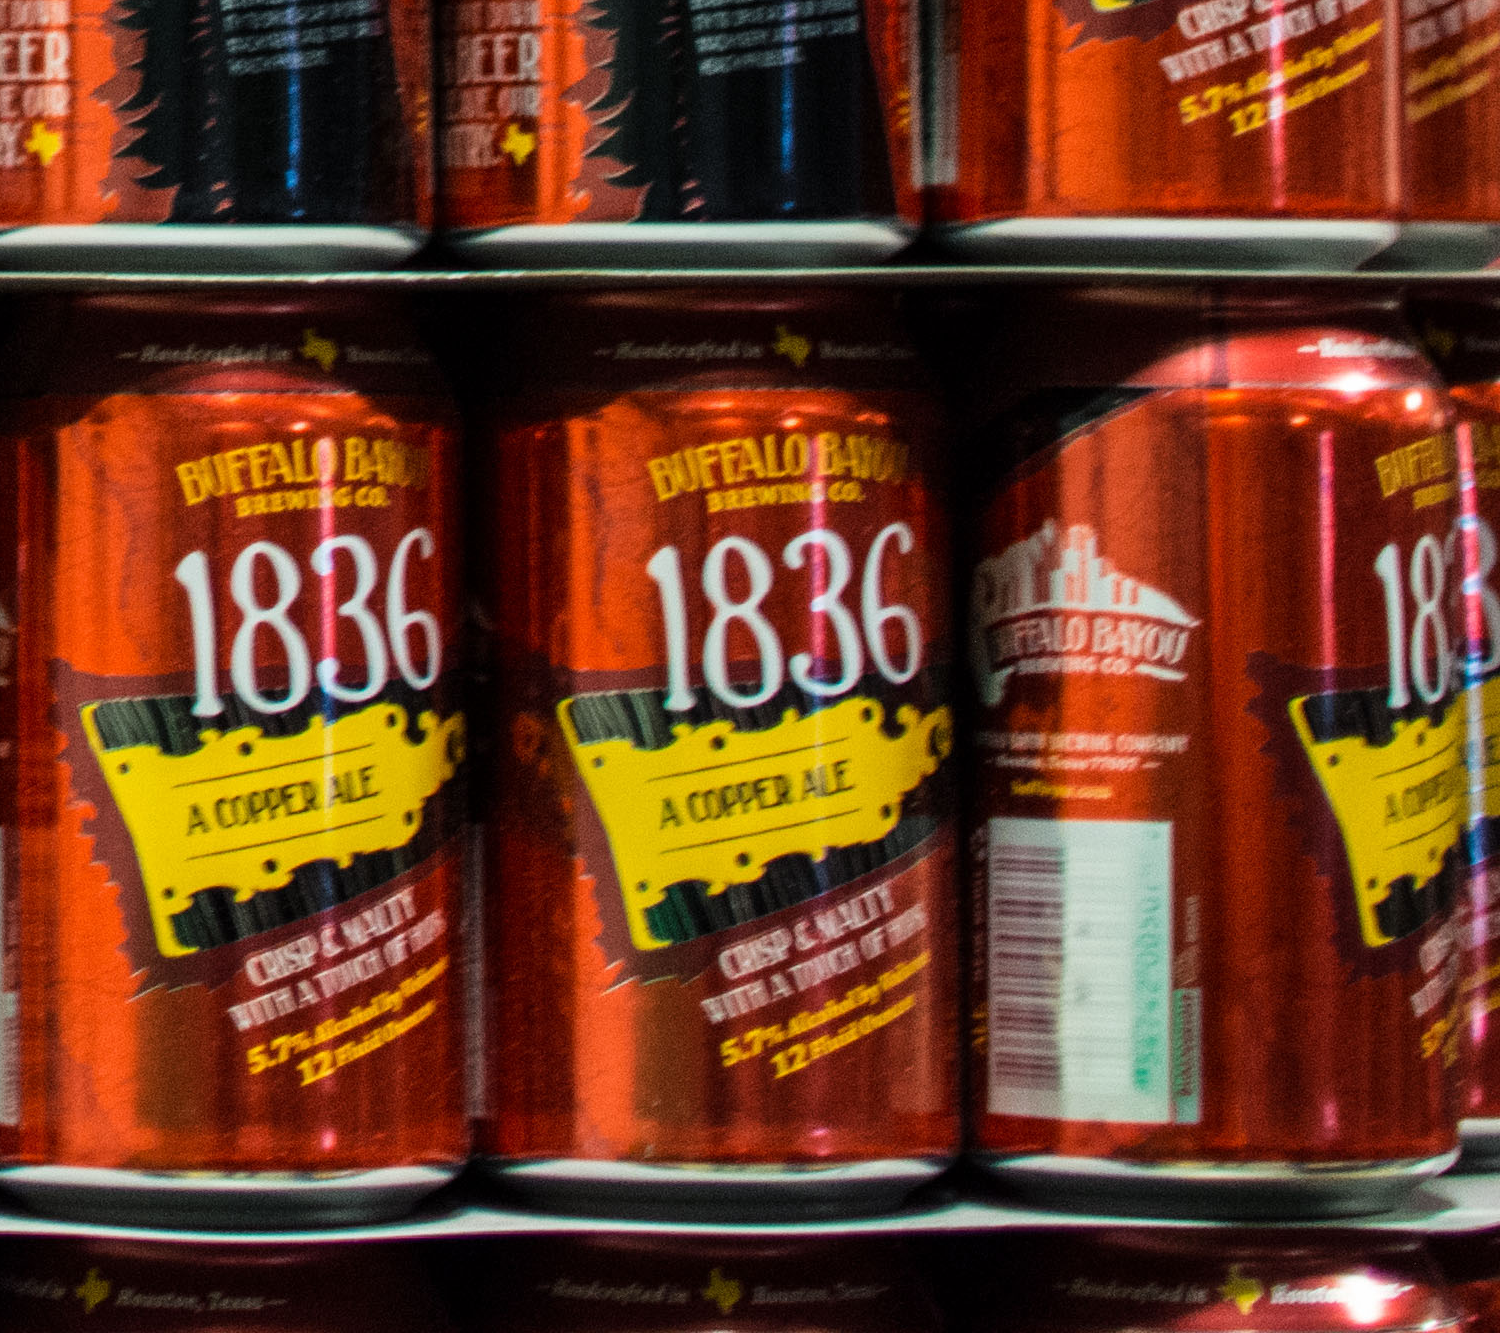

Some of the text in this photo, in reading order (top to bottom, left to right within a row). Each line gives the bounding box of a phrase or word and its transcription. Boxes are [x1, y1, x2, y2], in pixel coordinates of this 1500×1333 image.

[176, 440, 336, 506] BUFFALO
[647, 433, 909, 501] BUFFALO BAYOU
[176, 527, 440, 719] 1836
[647, 523, 921, 710] 1836
[216, 789, 318, 831] COPPER
[327, 766, 380, 805] ALE
[687, 779, 791, 823] COPPER
[799, 760, 854, 796] ALE
